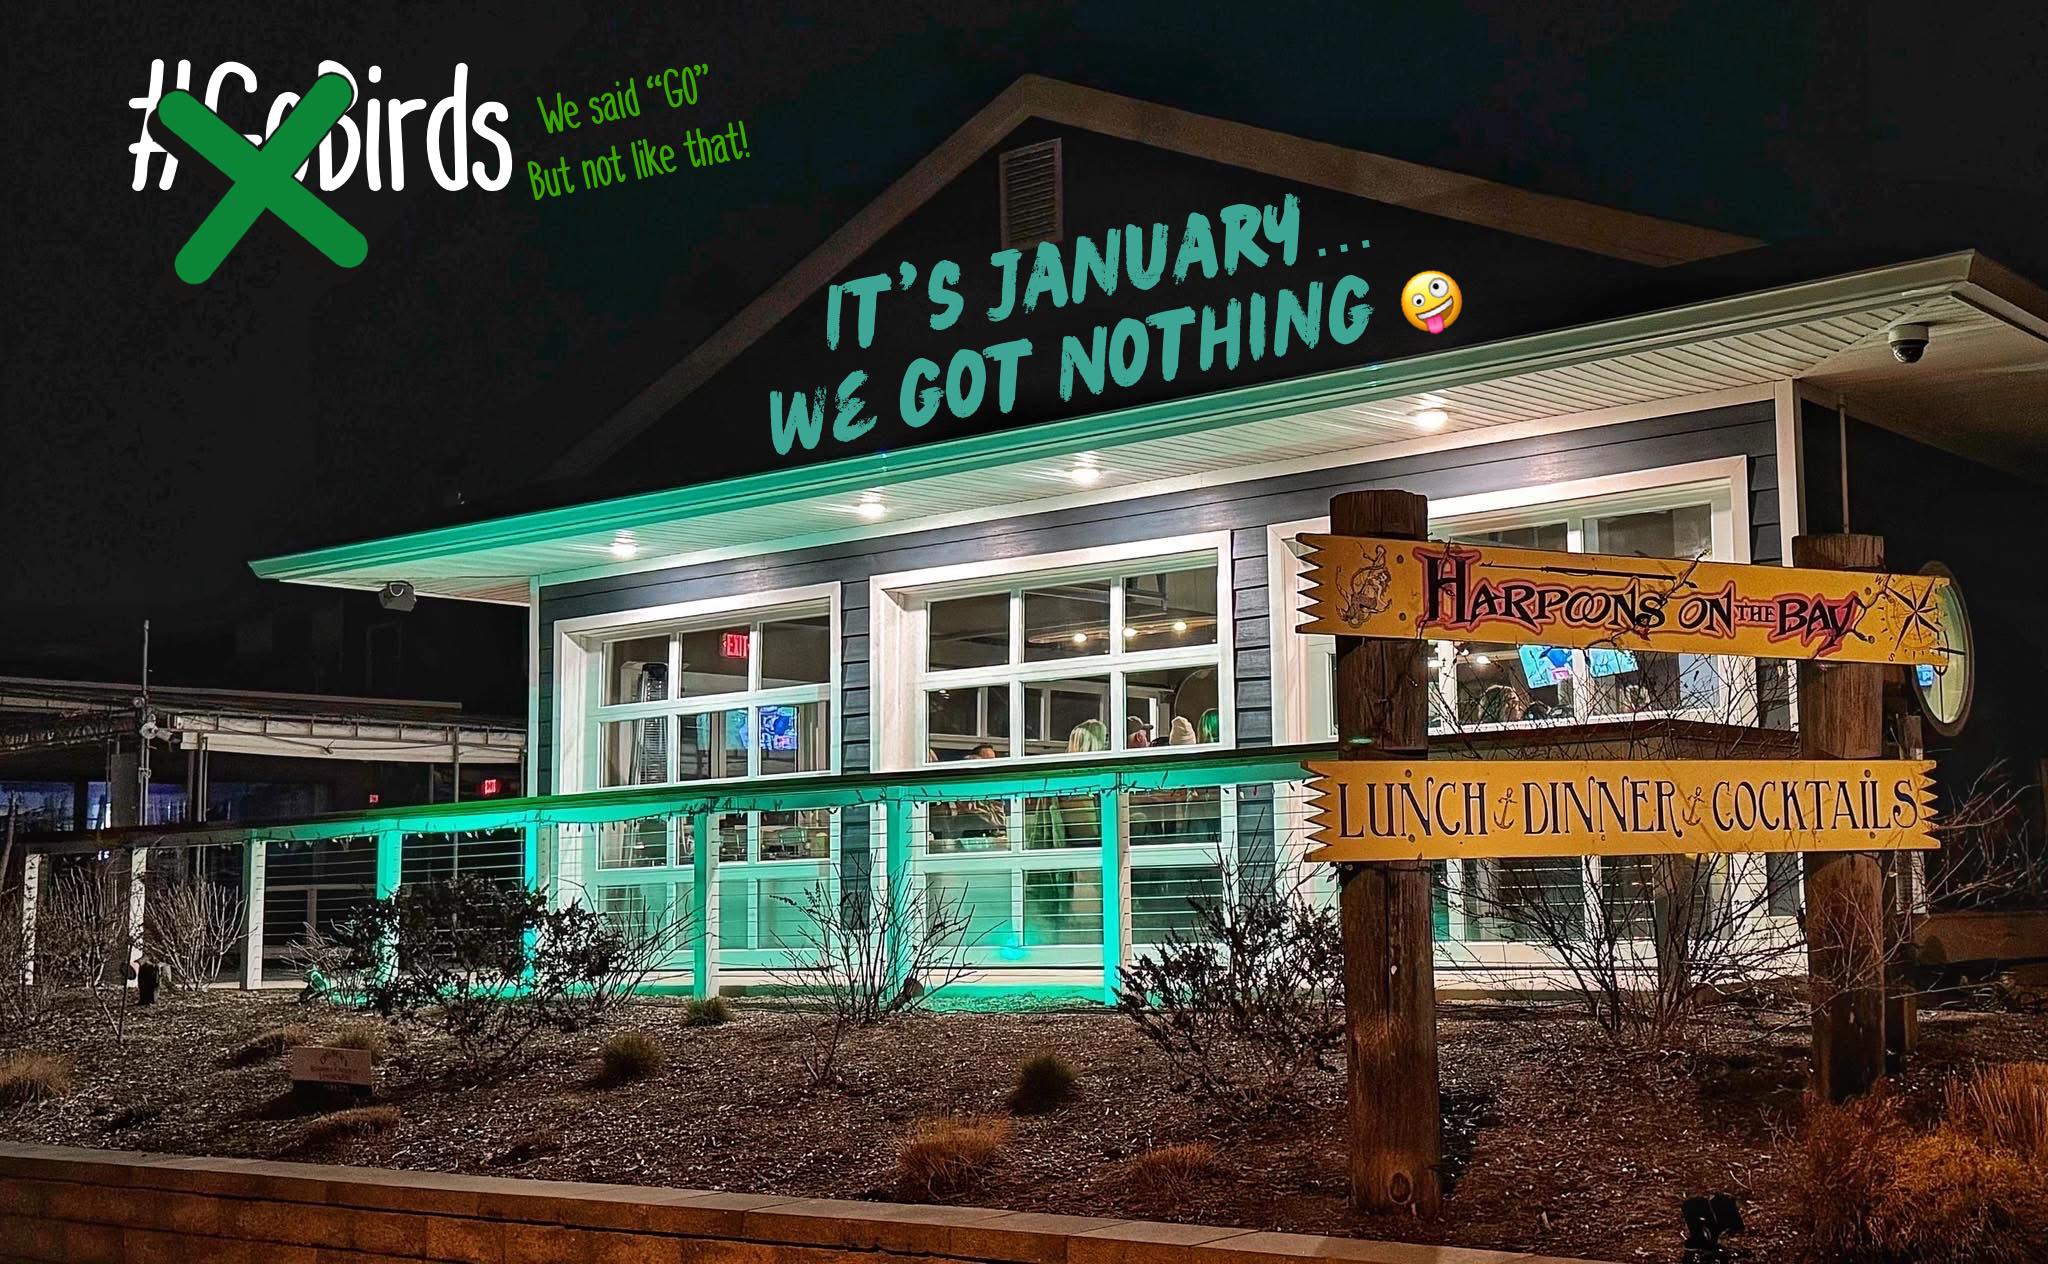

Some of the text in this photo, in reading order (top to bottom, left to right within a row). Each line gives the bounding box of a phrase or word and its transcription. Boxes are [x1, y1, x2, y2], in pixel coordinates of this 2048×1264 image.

[1417, 551, 1857, 651] HARPOONS ON THE BAY
[727, 633, 748, 657] EXIT
[1337, 775, 1918, 838] LUNCH DINNER COCKTAILS
